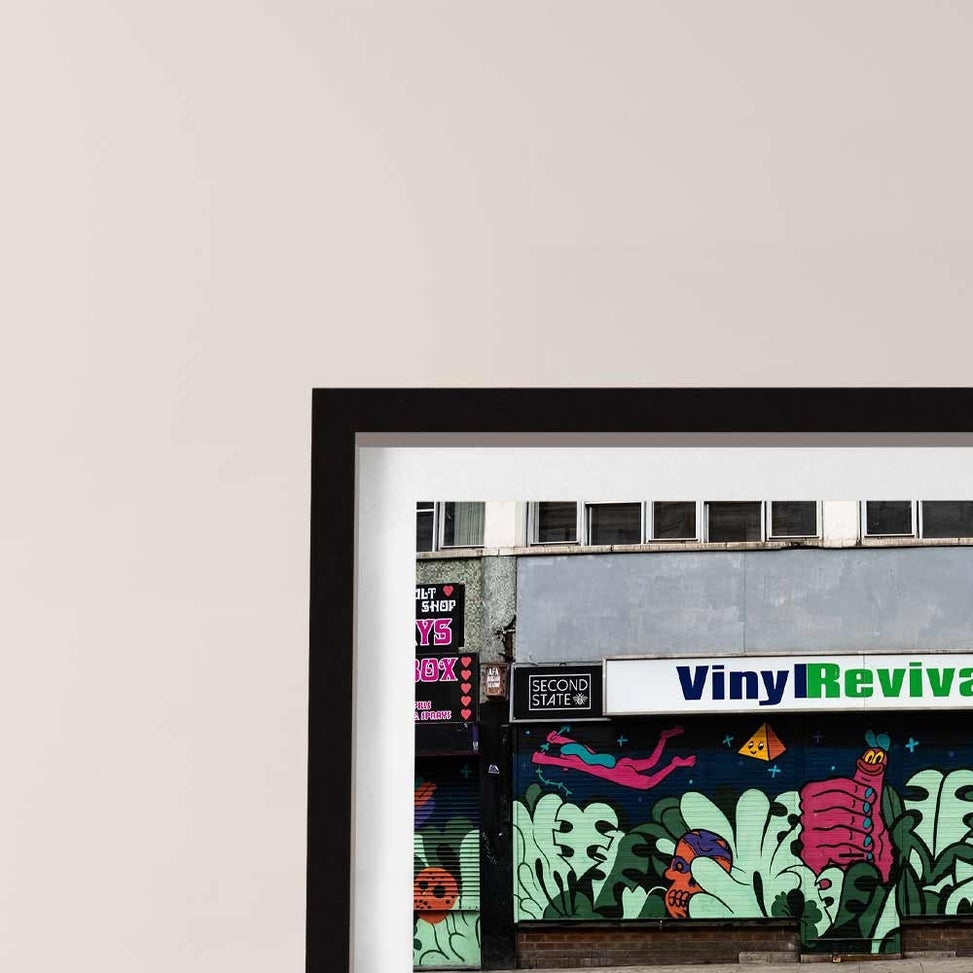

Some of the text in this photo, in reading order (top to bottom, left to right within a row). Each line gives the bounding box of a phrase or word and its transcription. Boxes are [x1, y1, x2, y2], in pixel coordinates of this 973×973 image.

[421, 600, 456, 612] SHOP
[415, 617, 453, 646] YS
[532, 679, 589, 692] SECOND
[532, 693, 571, 706] STATE
[421, 710, 452, 720] SPRAYS
